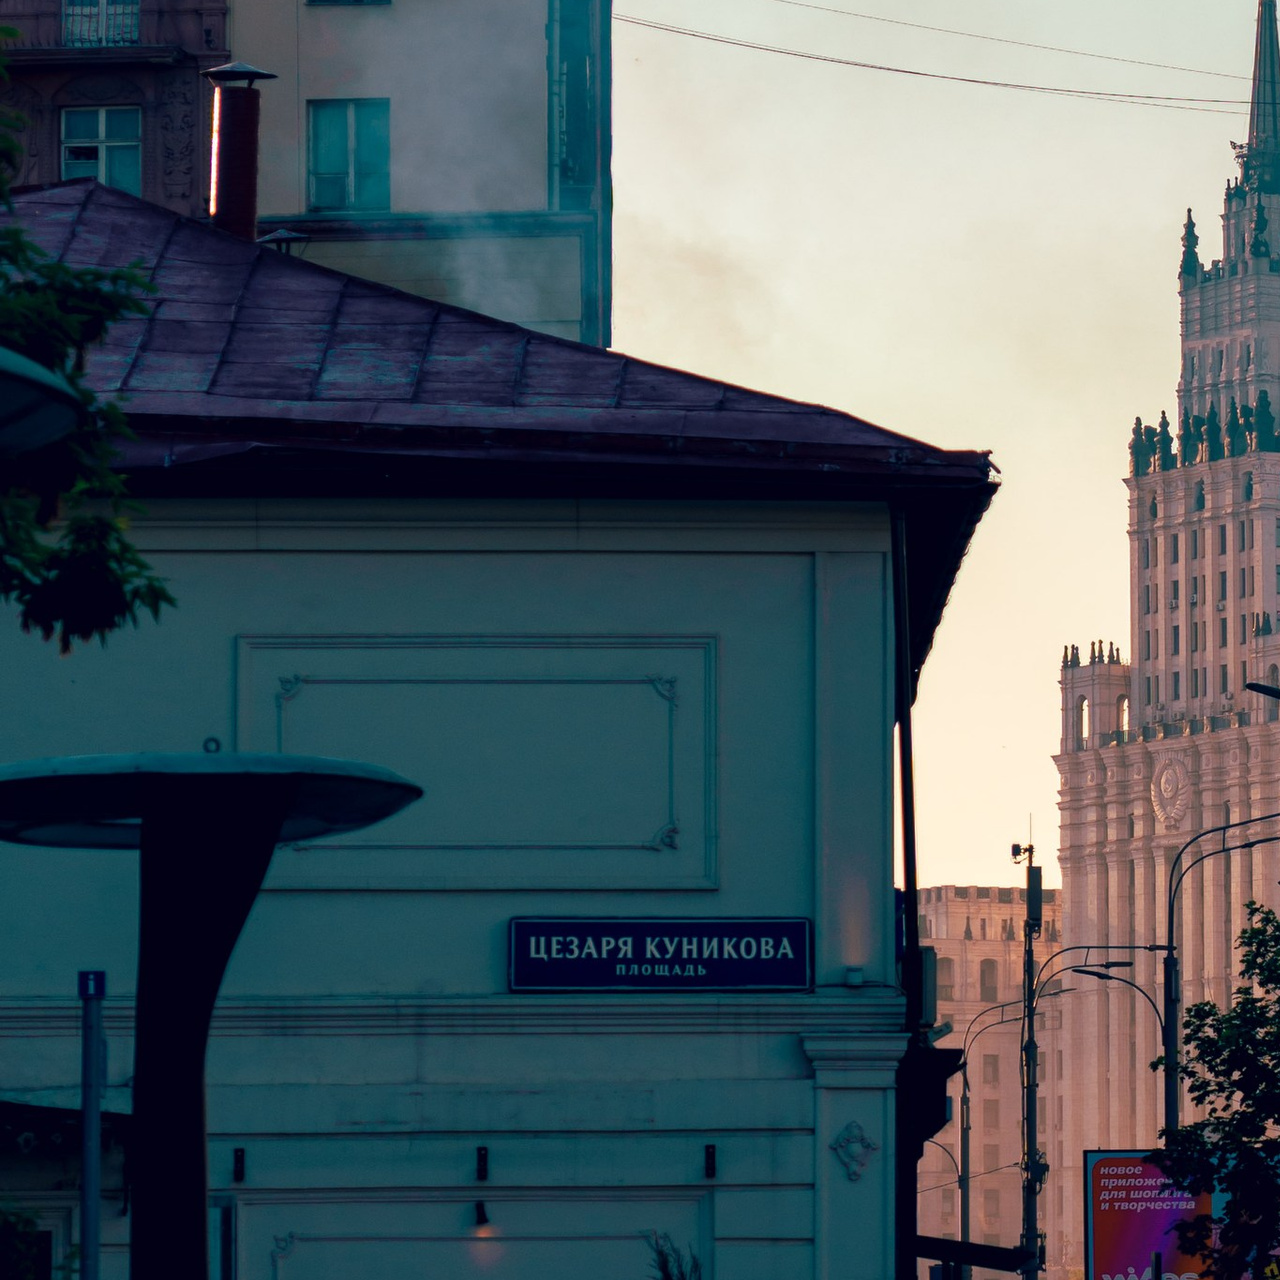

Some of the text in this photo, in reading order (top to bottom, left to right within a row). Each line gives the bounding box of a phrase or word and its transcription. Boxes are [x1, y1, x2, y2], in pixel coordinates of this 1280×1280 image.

[529, 936, 794, 961] ЦЕЗАРЯ КУНИКОВА
[615, 963, 707, 976] ПЛОЩАДЬ
[1099, 1166, 1143, 1175] новое
[1099, 1190, 1126, 1200] для
[1100, 1200, 1196, 1212] и творчества
